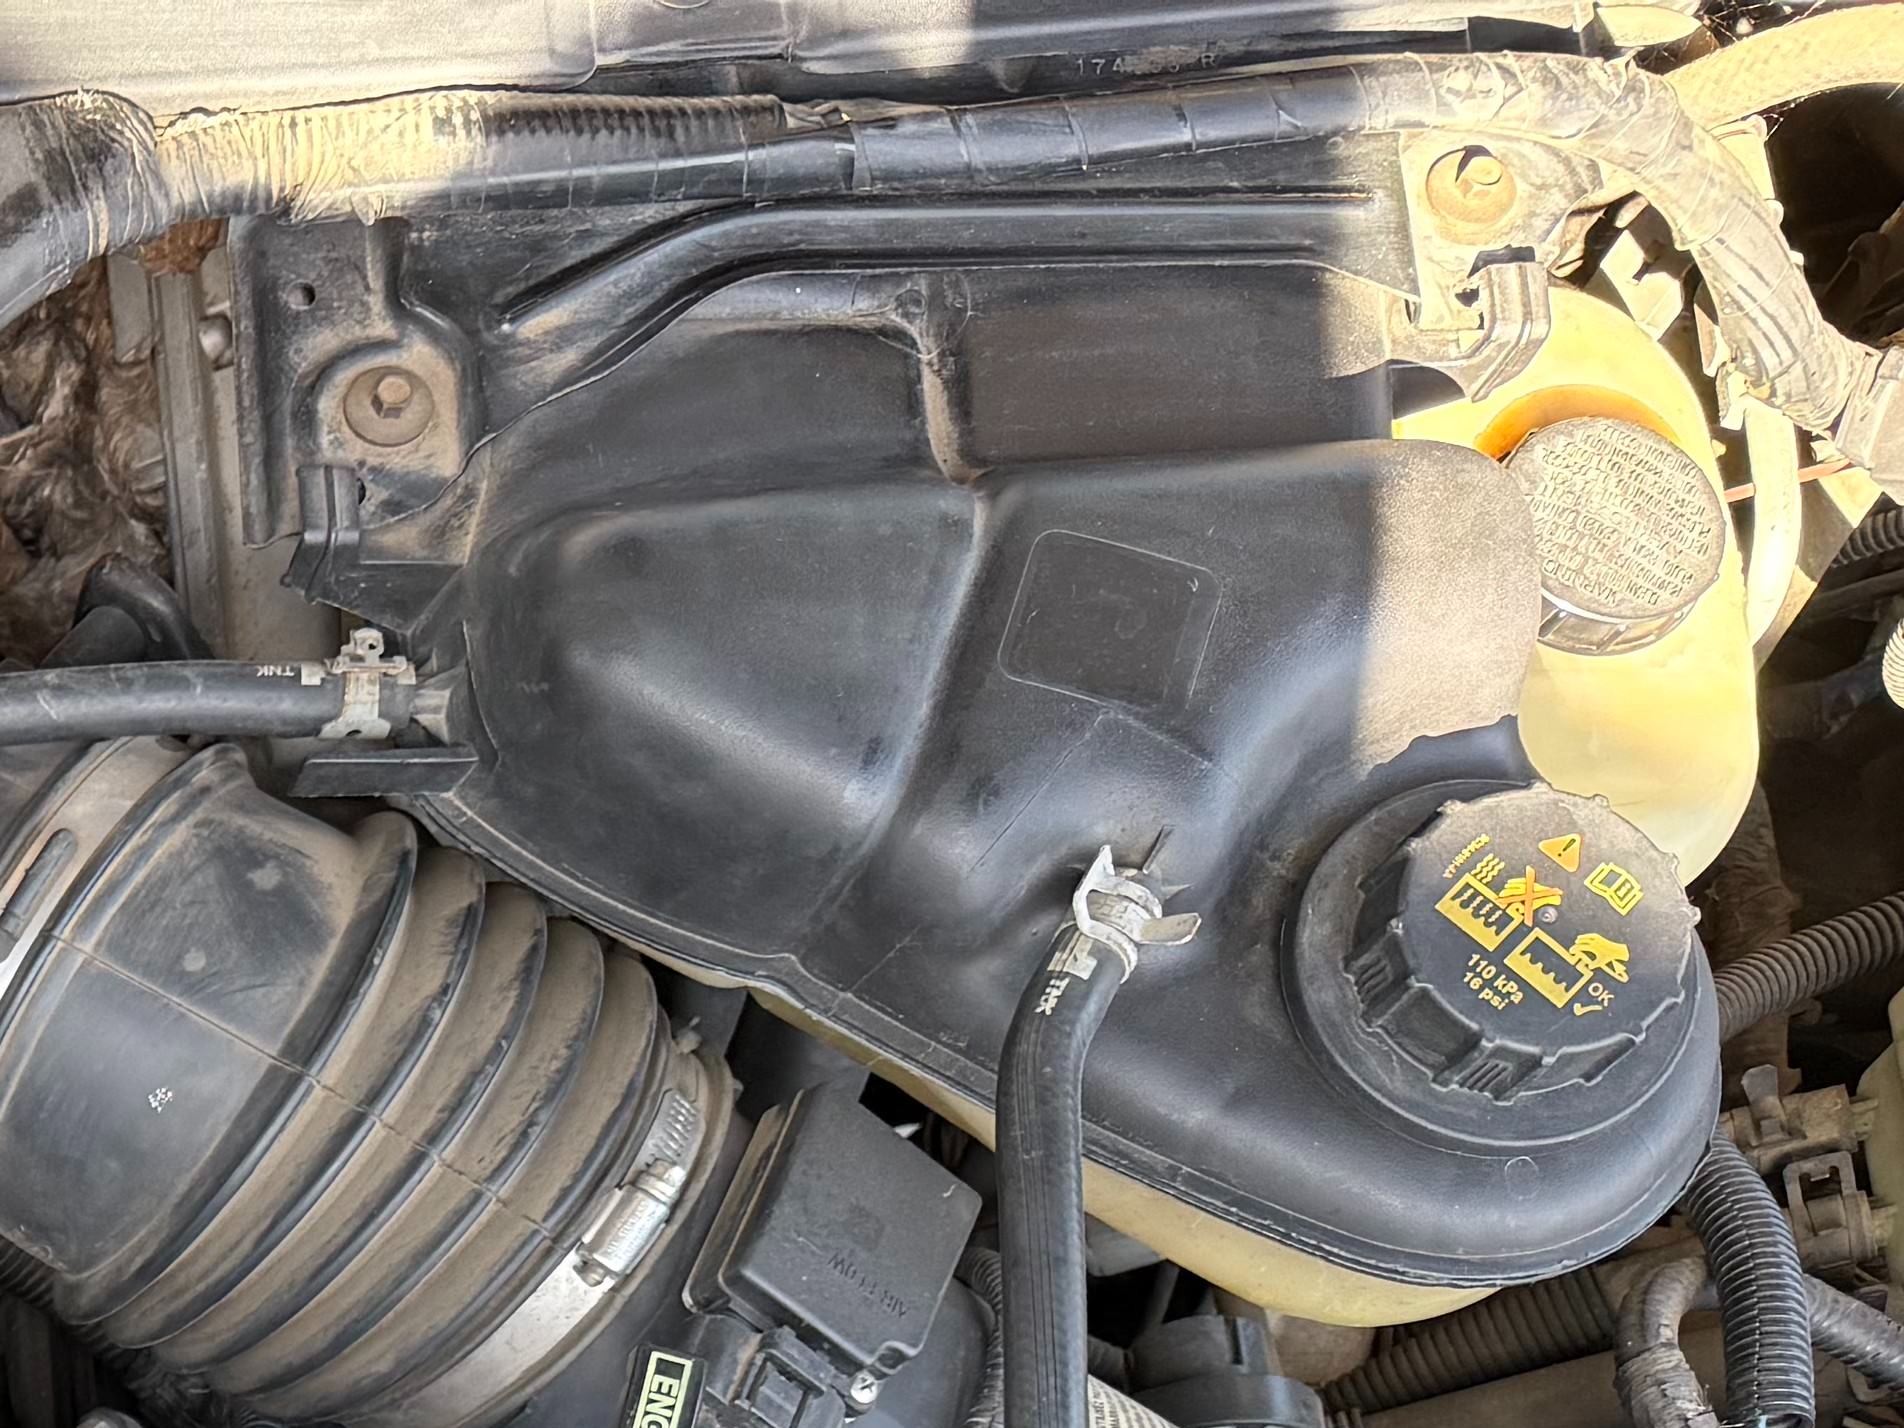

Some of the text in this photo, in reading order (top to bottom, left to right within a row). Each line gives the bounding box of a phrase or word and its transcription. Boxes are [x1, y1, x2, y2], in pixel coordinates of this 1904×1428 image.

[255, 665, 294, 677] TNK
[1463, 973, 1507, 1010] 16 psi
[1468, 954, 1524, 1005] 110 kPa
[1588, 983, 1614, 1007] OK
